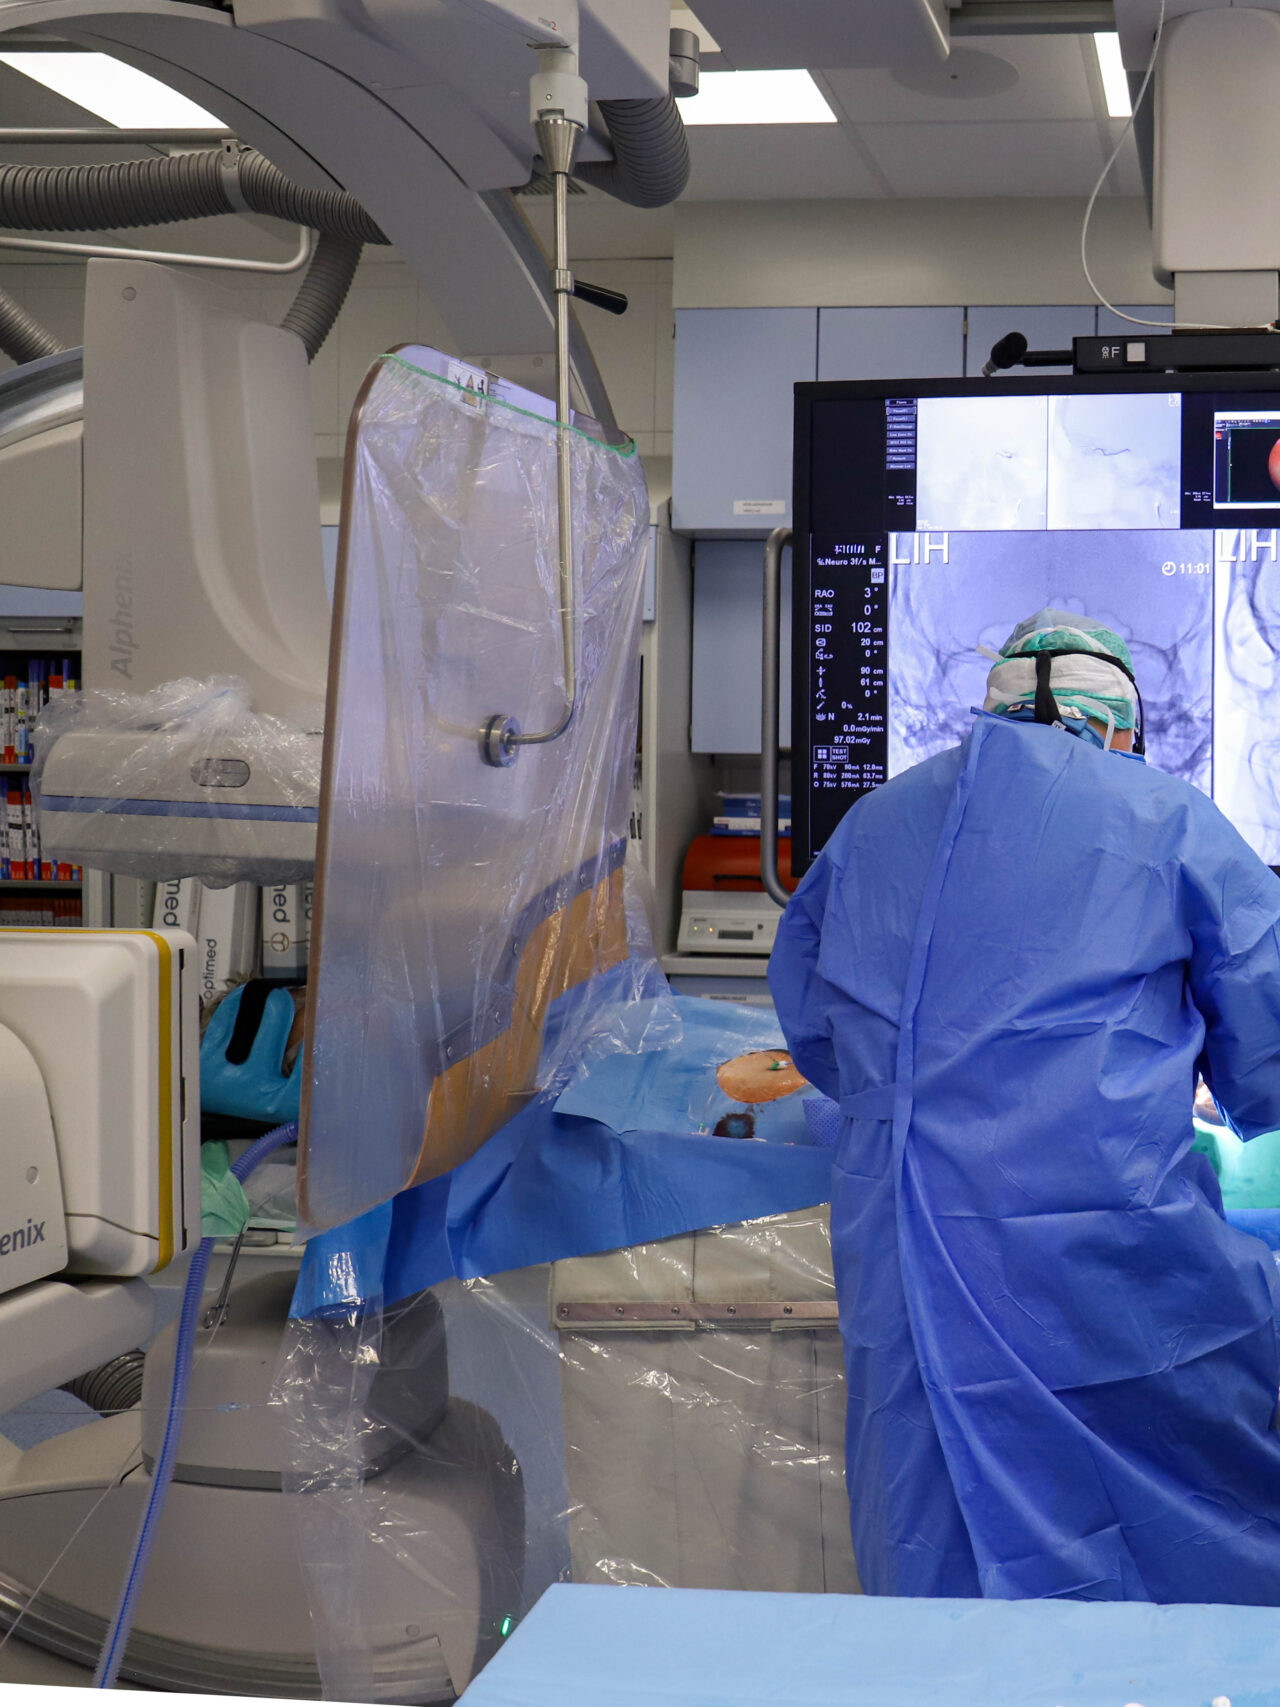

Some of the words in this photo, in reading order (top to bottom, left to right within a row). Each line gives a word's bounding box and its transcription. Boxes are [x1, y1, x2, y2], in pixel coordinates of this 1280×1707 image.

[890, 532, 949, 565] LIH
[1217, 528, 1277, 562] LIH
[1179, 564, 1211, 574] 11:01
[814, 589, 835, 598] RAO
[814, 624, 832, 633] SID
[851, 621, 871, 633] 102
[860, 638, 871, 646] 20
[860, 666, 870, 675] 90
[860, 678, 870, 686] 61
[828, 712, 835, 720] N
[203, 938, 217, 1001] optimed
[0, 1218, 46, 1256] enix
